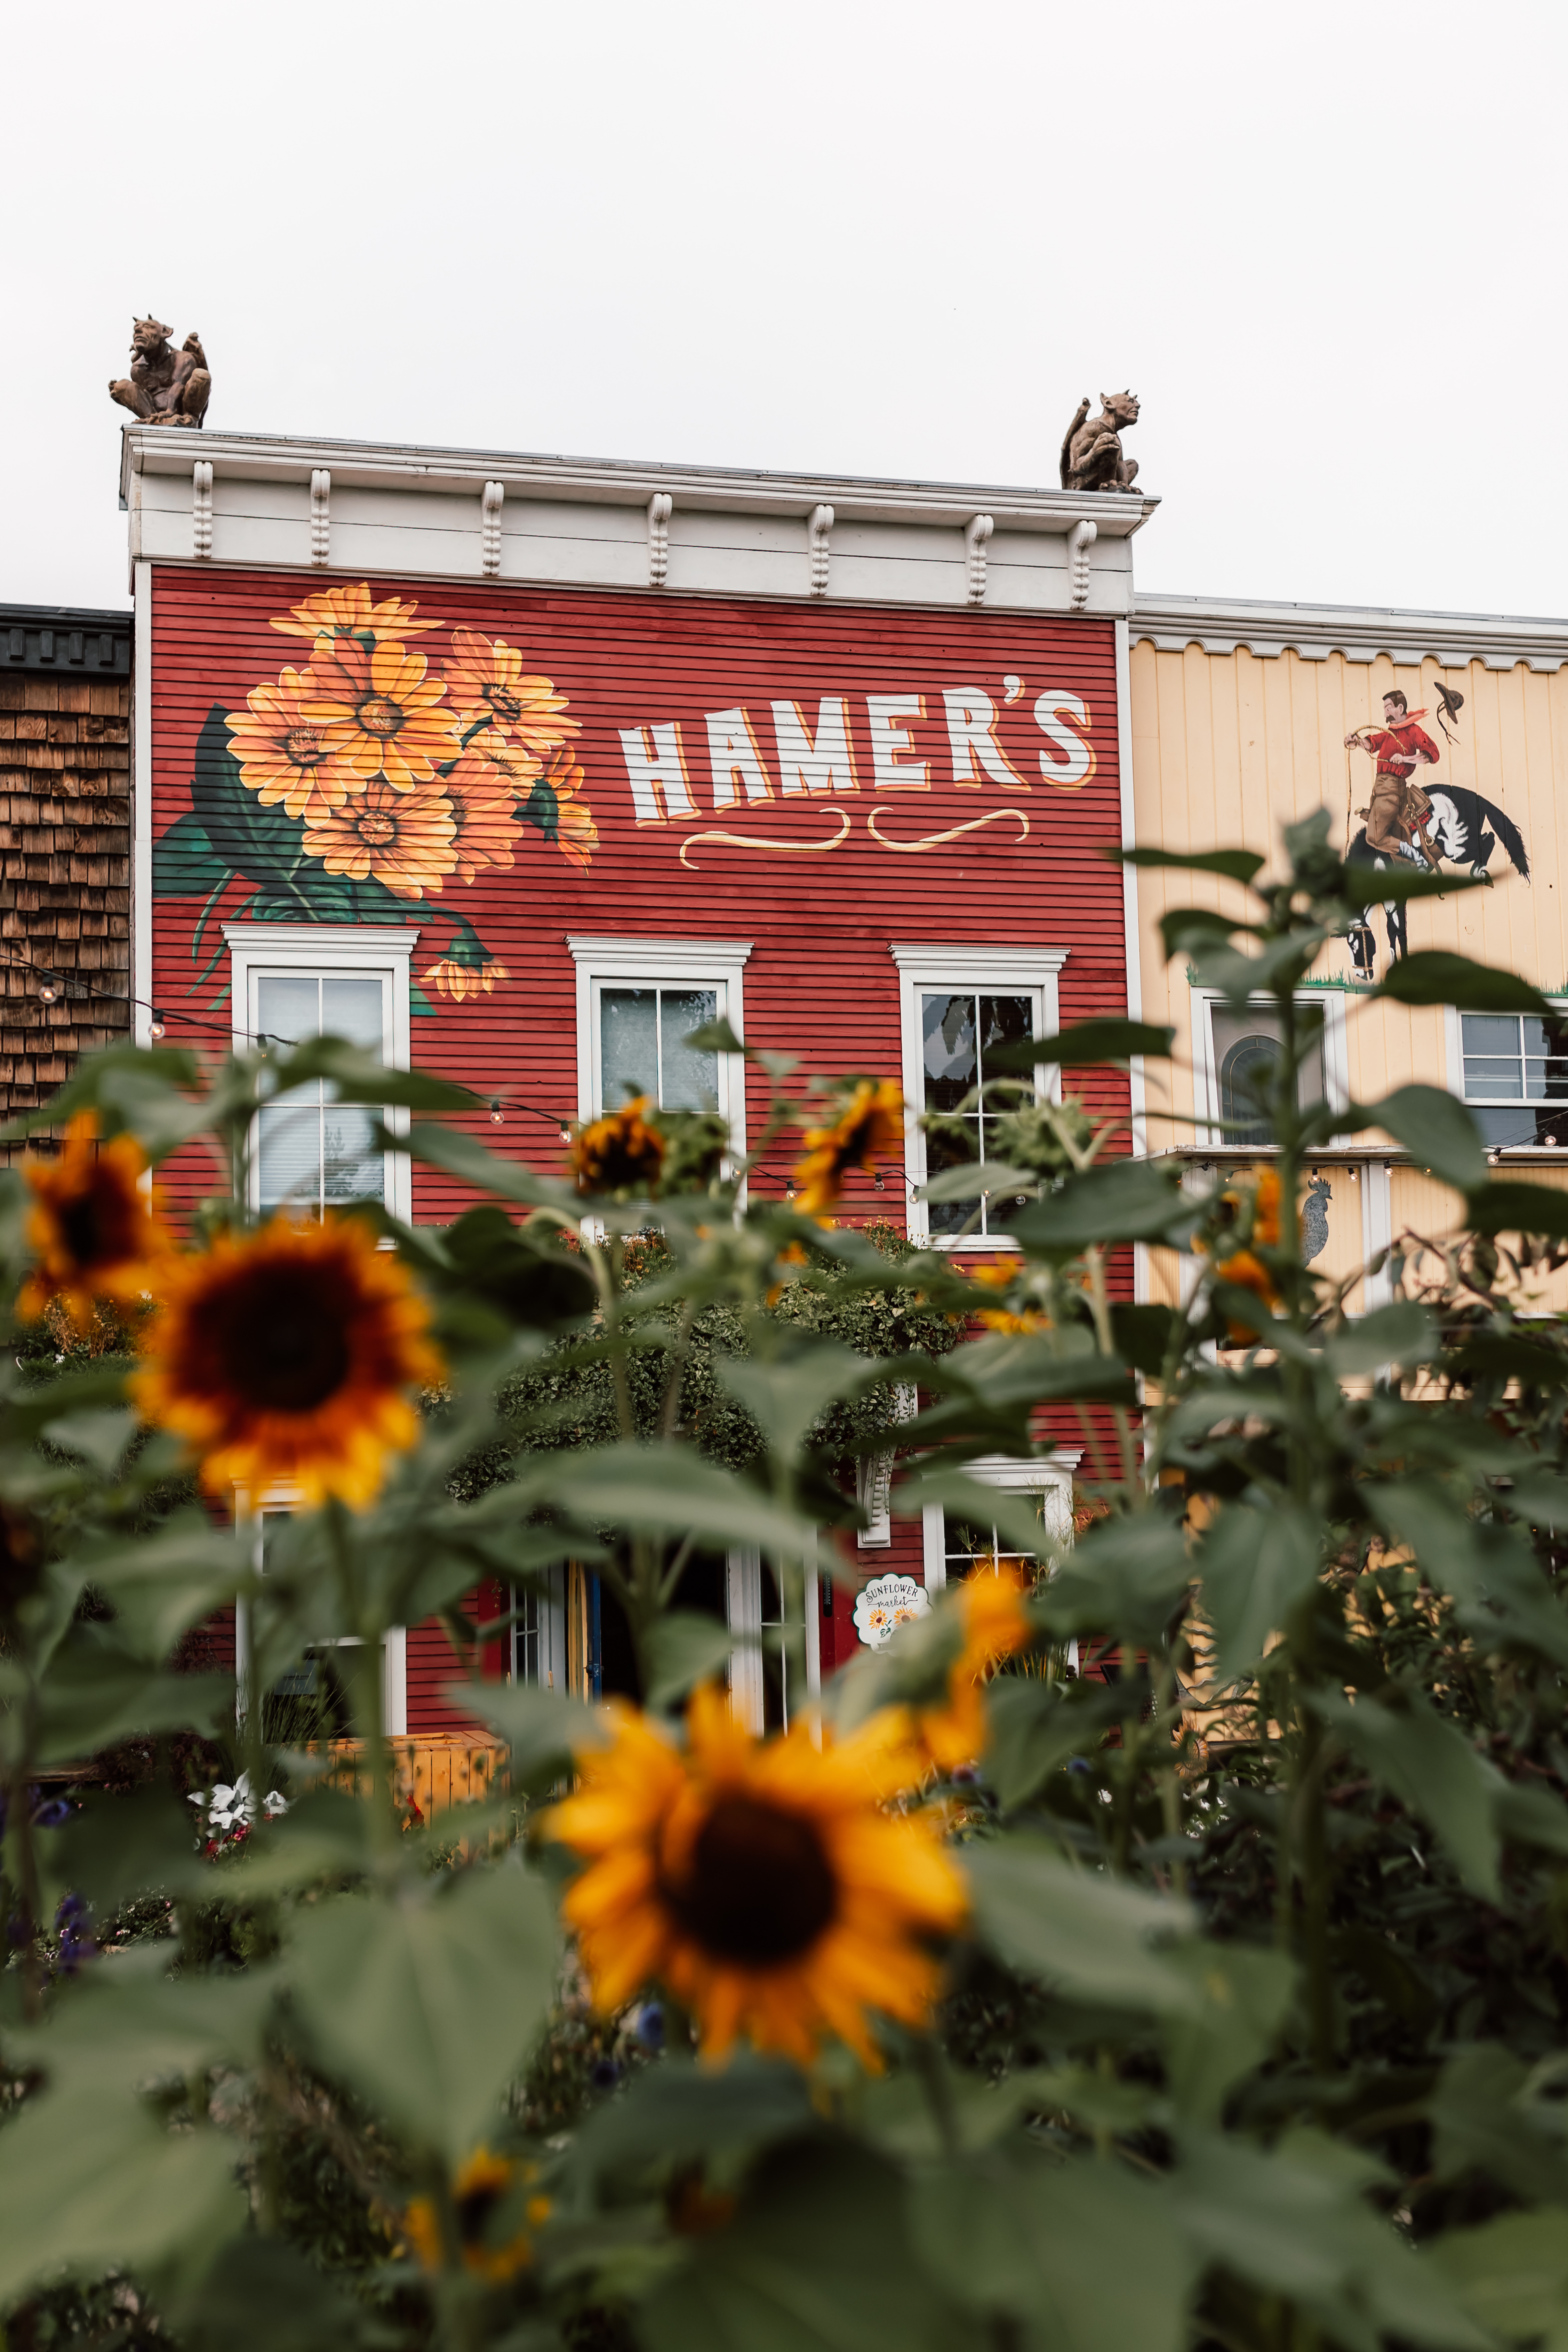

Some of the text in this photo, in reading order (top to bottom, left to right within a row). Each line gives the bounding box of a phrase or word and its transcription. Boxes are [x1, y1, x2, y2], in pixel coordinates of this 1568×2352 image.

[618, 675, 1097, 827] HAMER'S
[866, 1584, 918, 1603] SUNFLOWER
[868, 1595, 918, 1607] market
